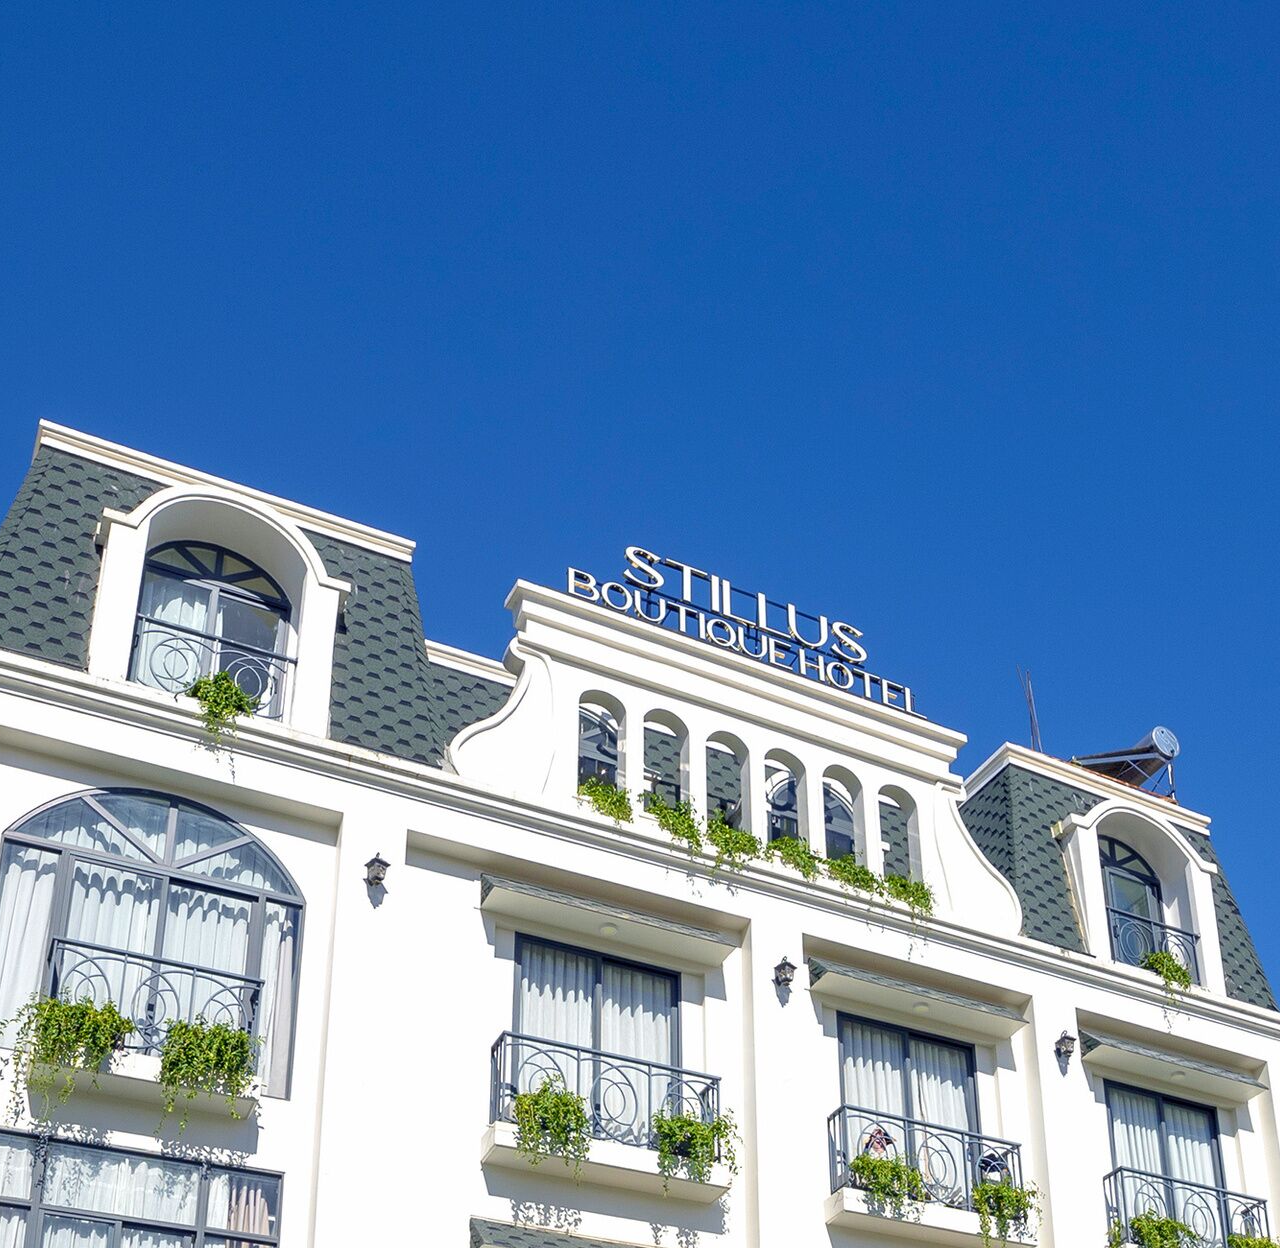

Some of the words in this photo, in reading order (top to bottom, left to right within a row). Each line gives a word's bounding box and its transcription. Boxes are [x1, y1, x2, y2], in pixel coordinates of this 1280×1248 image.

[567, 567, 793, 671] BOUTIQUE
[799, 649, 927, 720] HOTEL
[623, 546, 868, 665] STILLUS
